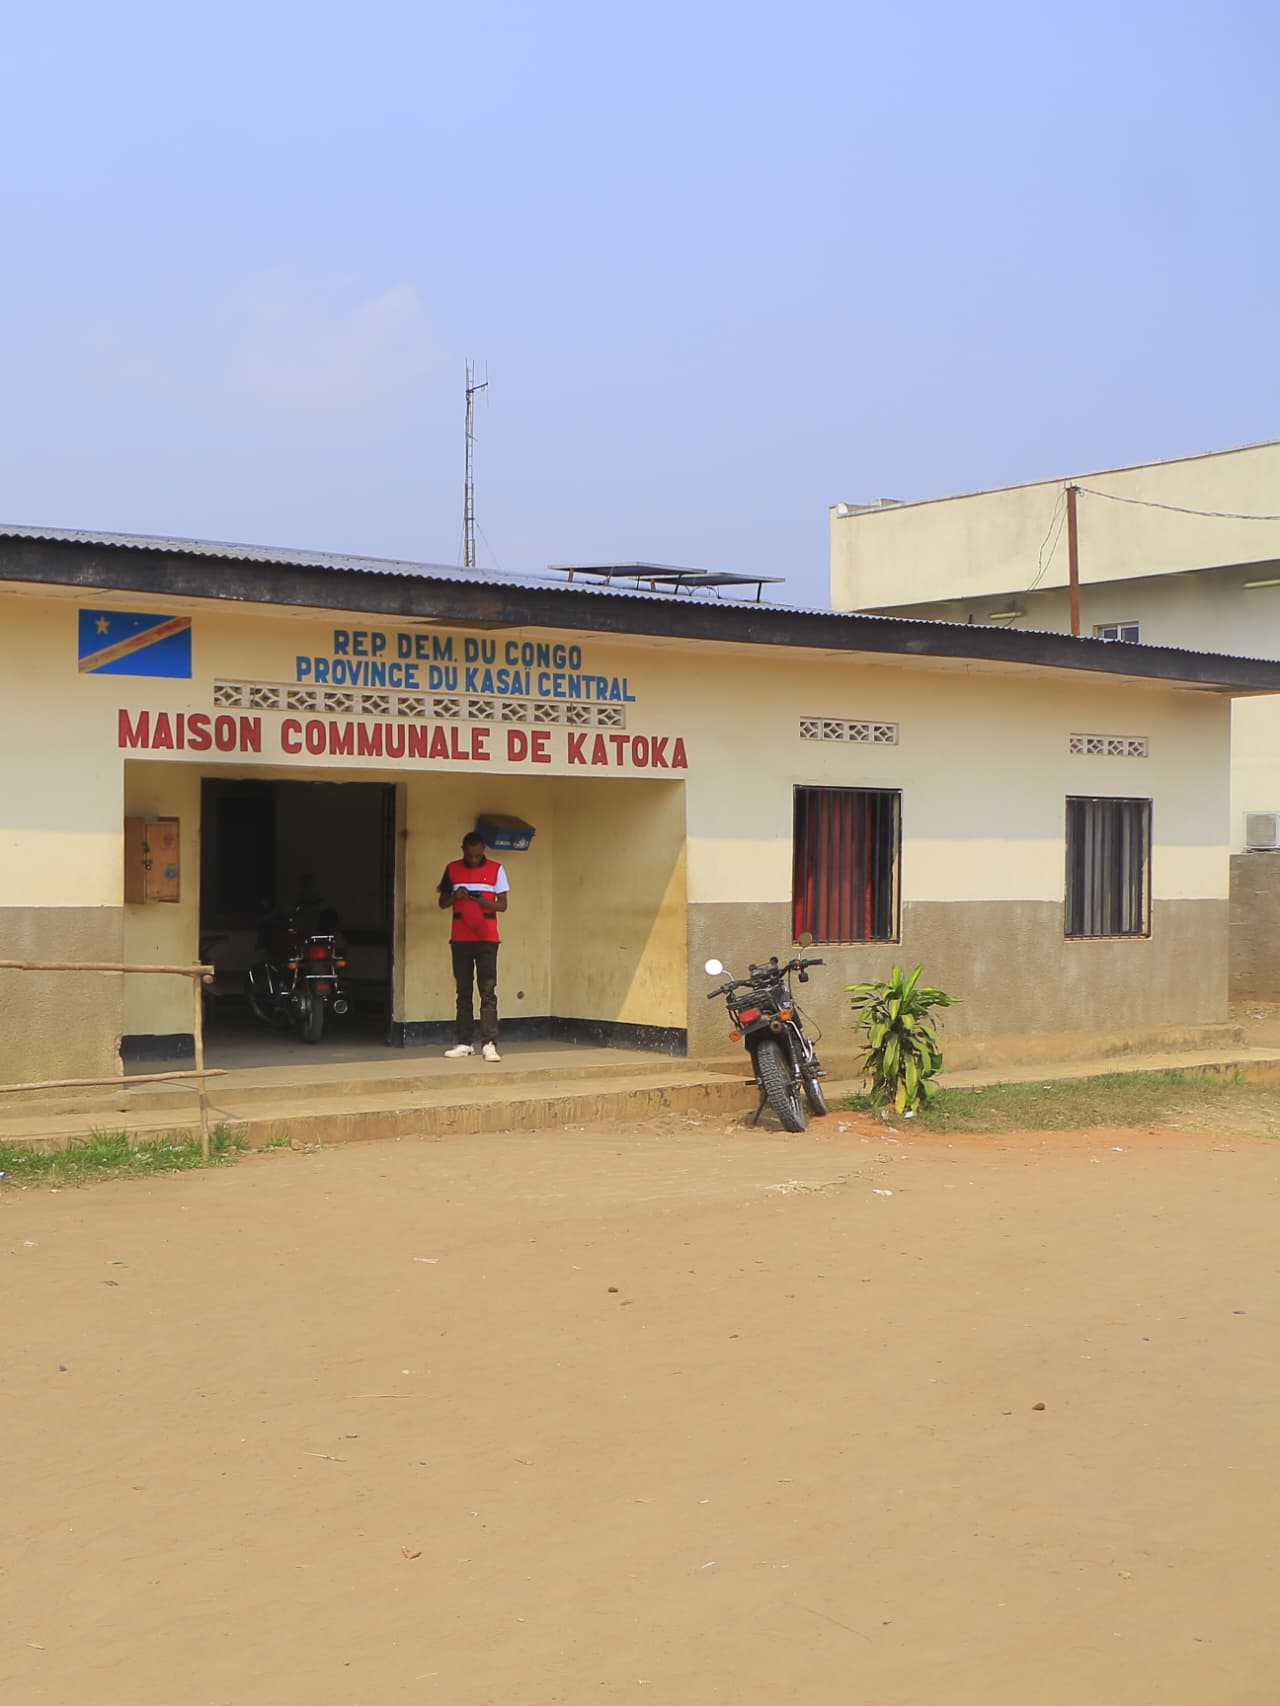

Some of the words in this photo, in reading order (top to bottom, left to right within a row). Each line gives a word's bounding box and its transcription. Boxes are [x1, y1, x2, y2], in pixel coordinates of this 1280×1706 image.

[334, 630, 387, 657] REP.
[398, 634, 458, 662] DEM.
[464, 637, 497, 664] DU
[505, 642, 582, 670] CONGO
[296, 656, 420, 689] PROVINCE
[427, 665, 459, 691] DU
[465, 666, 532, 696] KASAÏ
[537, 672, 636, 702] CENTRAL
[118, 709, 262, 753] MAISON
[280, 719, 491, 761] COMMUNALE
[507, 730, 552, 763] DE
[567, 733, 689, 770] KATOKA
